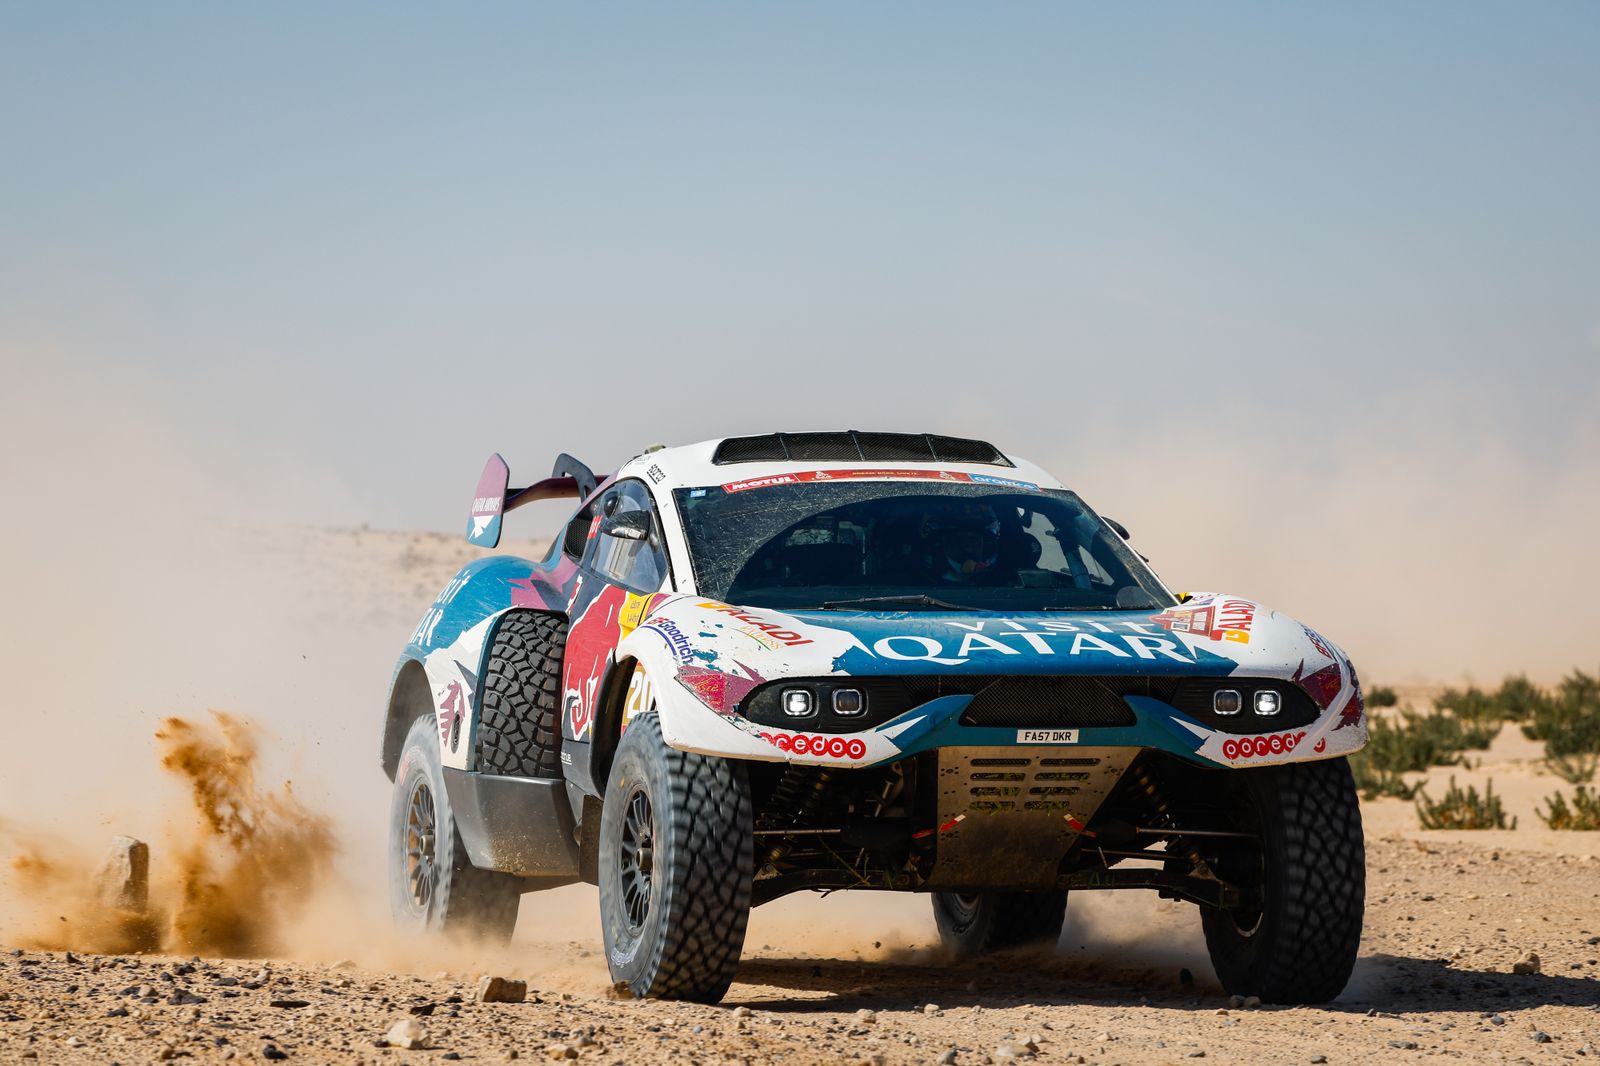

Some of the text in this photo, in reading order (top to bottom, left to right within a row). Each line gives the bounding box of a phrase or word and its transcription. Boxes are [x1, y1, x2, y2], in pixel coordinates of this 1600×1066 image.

[732, 476, 796, 490] MOTUL
[873, 632, 1196, 666] QATAR
[1052, 731, 1072, 742] DKR
